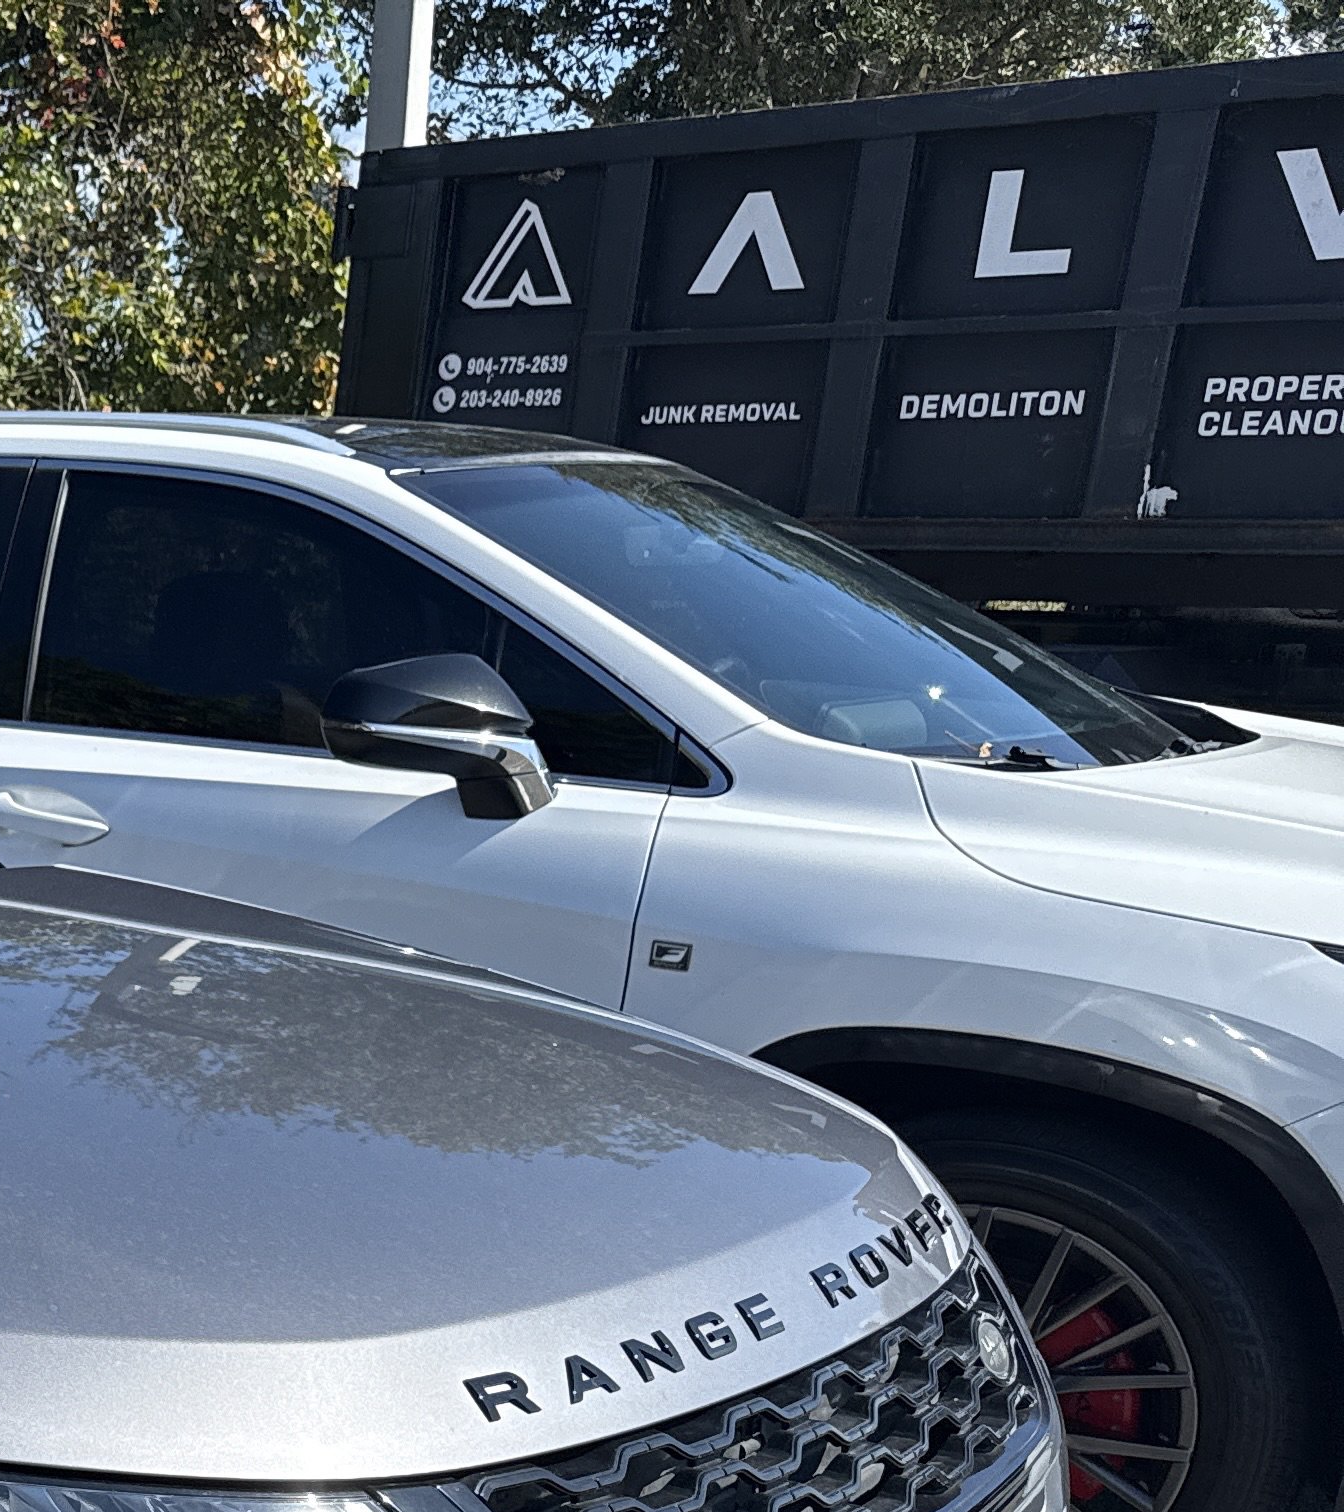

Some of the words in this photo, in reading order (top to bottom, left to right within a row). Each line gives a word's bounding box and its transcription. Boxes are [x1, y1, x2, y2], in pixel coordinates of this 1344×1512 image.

[466, 354, 568, 376] 904-775-2639
[459, 387, 562, 408] 203-240-8926
[1203, 374, 1344, 403] PROPER
[640, 404, 697, 425] JUNK
[700, 401, 801, 423] REMOVAL
[899, 389, 1086, 420] DEMOLITON
[1197, 408, 1344, 437] CLEANO
[462, 1292, 786, 1423] RANGE
[809, 1193, 953, 1309] ROVER
